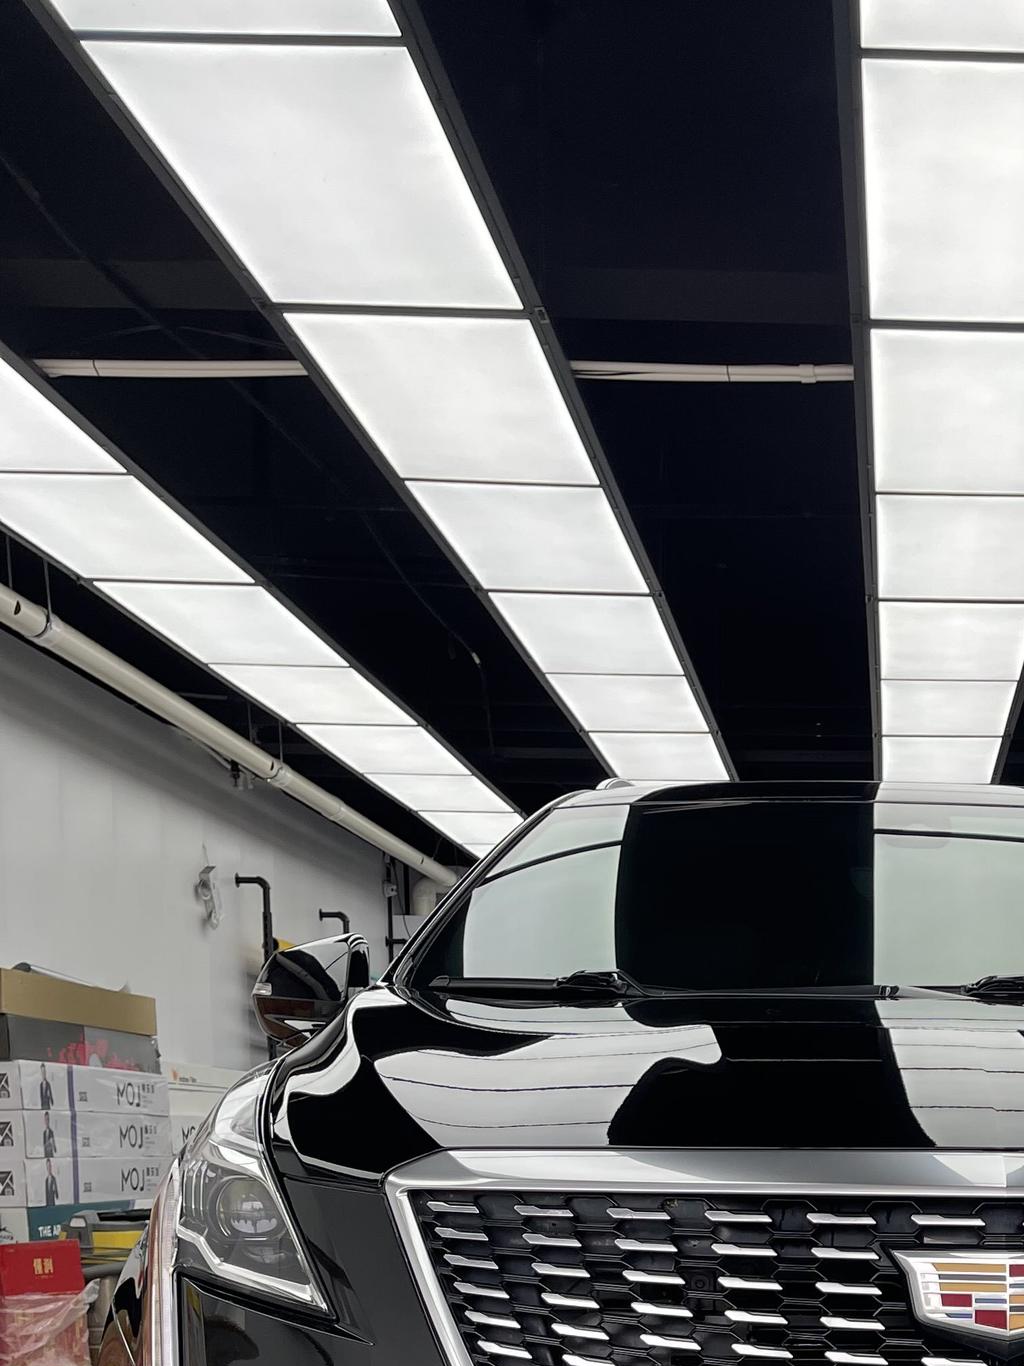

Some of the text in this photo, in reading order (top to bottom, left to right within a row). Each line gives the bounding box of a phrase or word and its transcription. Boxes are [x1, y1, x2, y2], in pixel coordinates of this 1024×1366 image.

[116, 1082, 141, 1108] MOJ
[119, 1124, 143, 1149] MOJ
[121, 1167, 145, 1192] MOJ
[37, 1225, 52, 1238] THE
